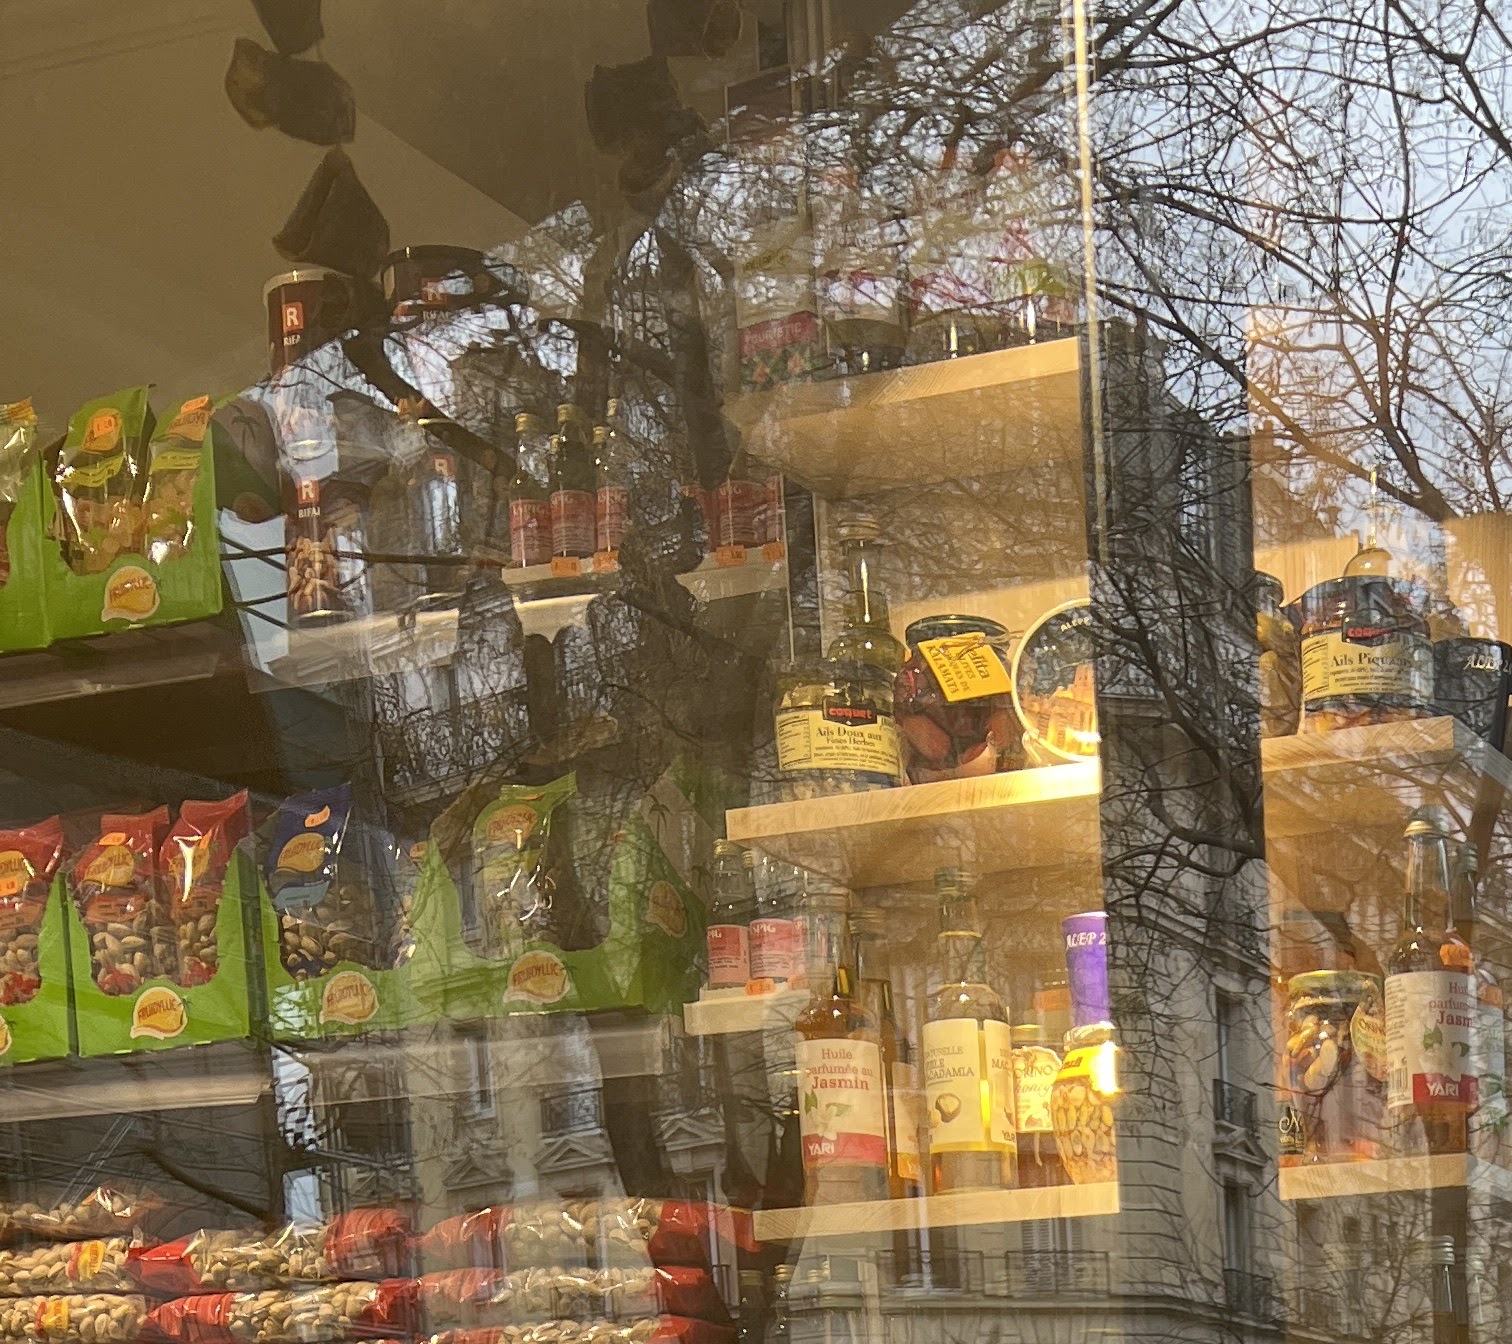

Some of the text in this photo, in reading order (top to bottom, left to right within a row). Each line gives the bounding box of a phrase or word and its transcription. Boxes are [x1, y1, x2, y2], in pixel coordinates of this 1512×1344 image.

[286, 308, 298, 326] R
[302, 480, 314, 499] R
[828, 706, 872, 720] coquet
[821, 1048, 853, 1060] Huile
[811, 1076, 870, 1091] Jasmin
[1426, 1082, 1458, 1097] YARI
[807, 1142, 835, 1156] YARI
